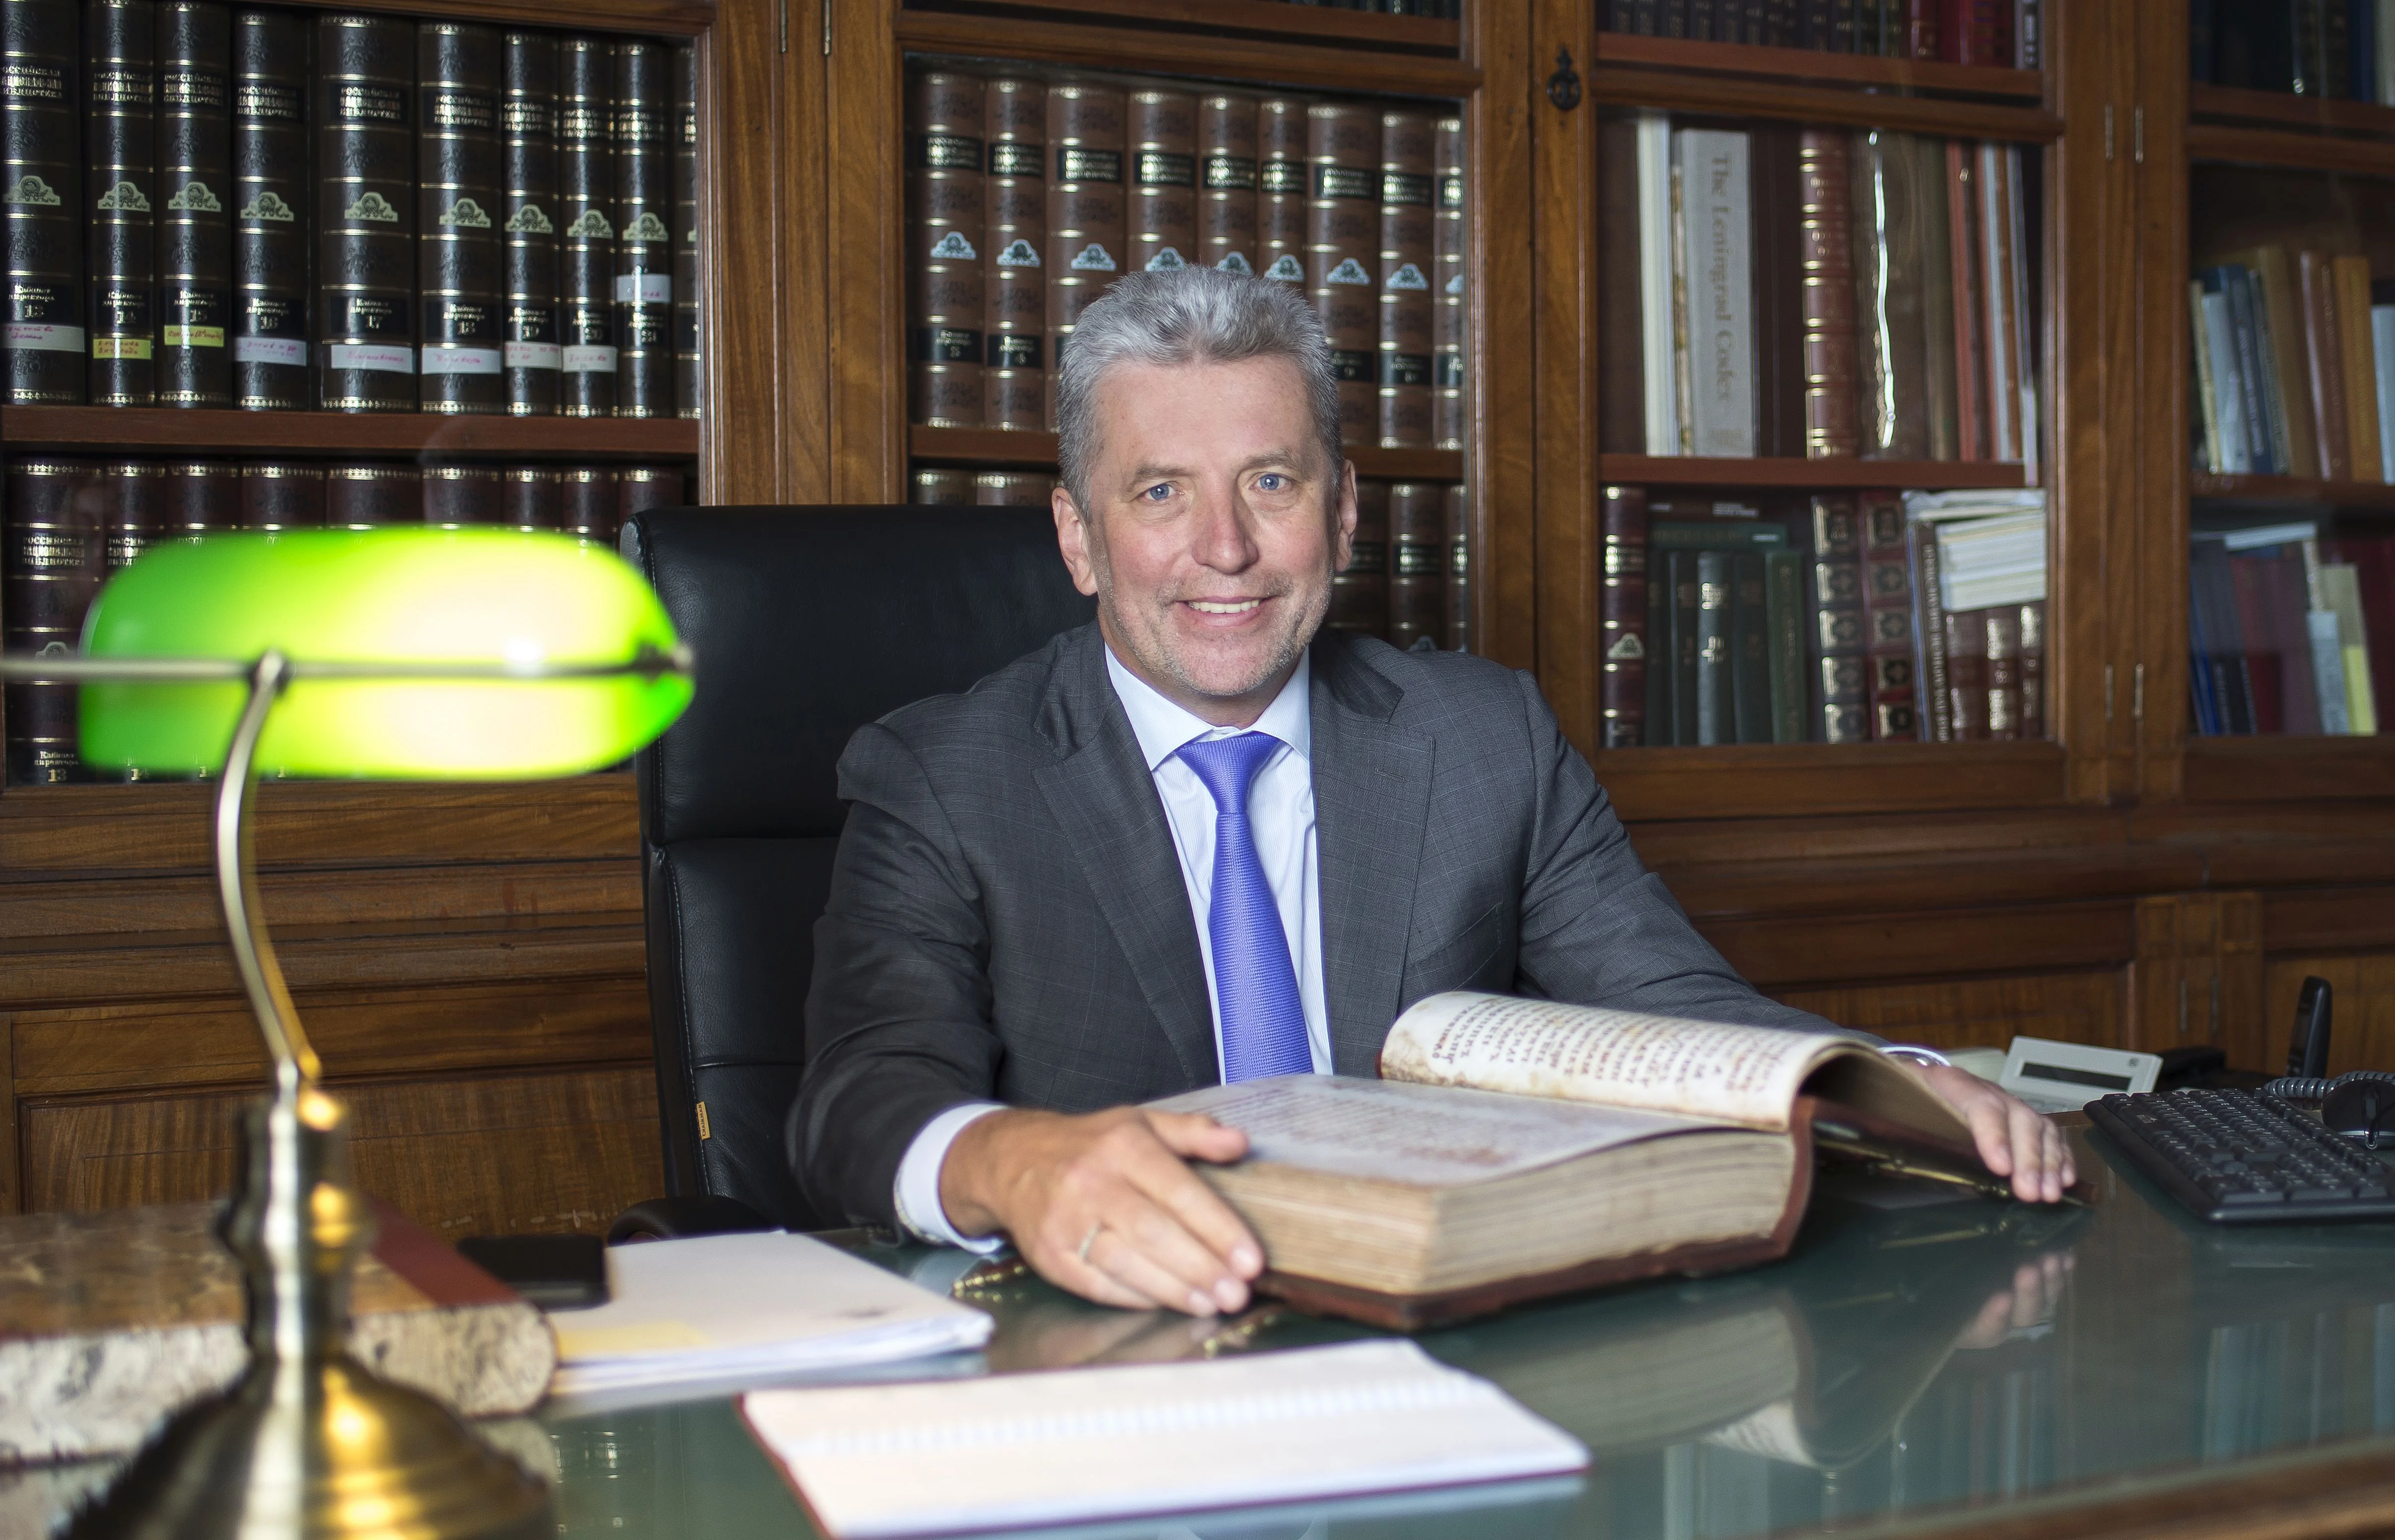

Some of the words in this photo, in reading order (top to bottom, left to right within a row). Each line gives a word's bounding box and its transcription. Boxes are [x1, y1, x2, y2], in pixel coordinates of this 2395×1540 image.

[1711, 151, 1731, 196] The
[1709, 206, 1733, 320] Leningrad
[25, 304, 45, 318] 13
[116, 311, 137, 324] 14
[190, 309, 207, 322] 15
[367, 315, 383, 329] 17
[1715, 330, 1736, 399] Codex
[48, 769, 67, 782] 13
[698, 1104, 706, 1136] CHAIRMAN
